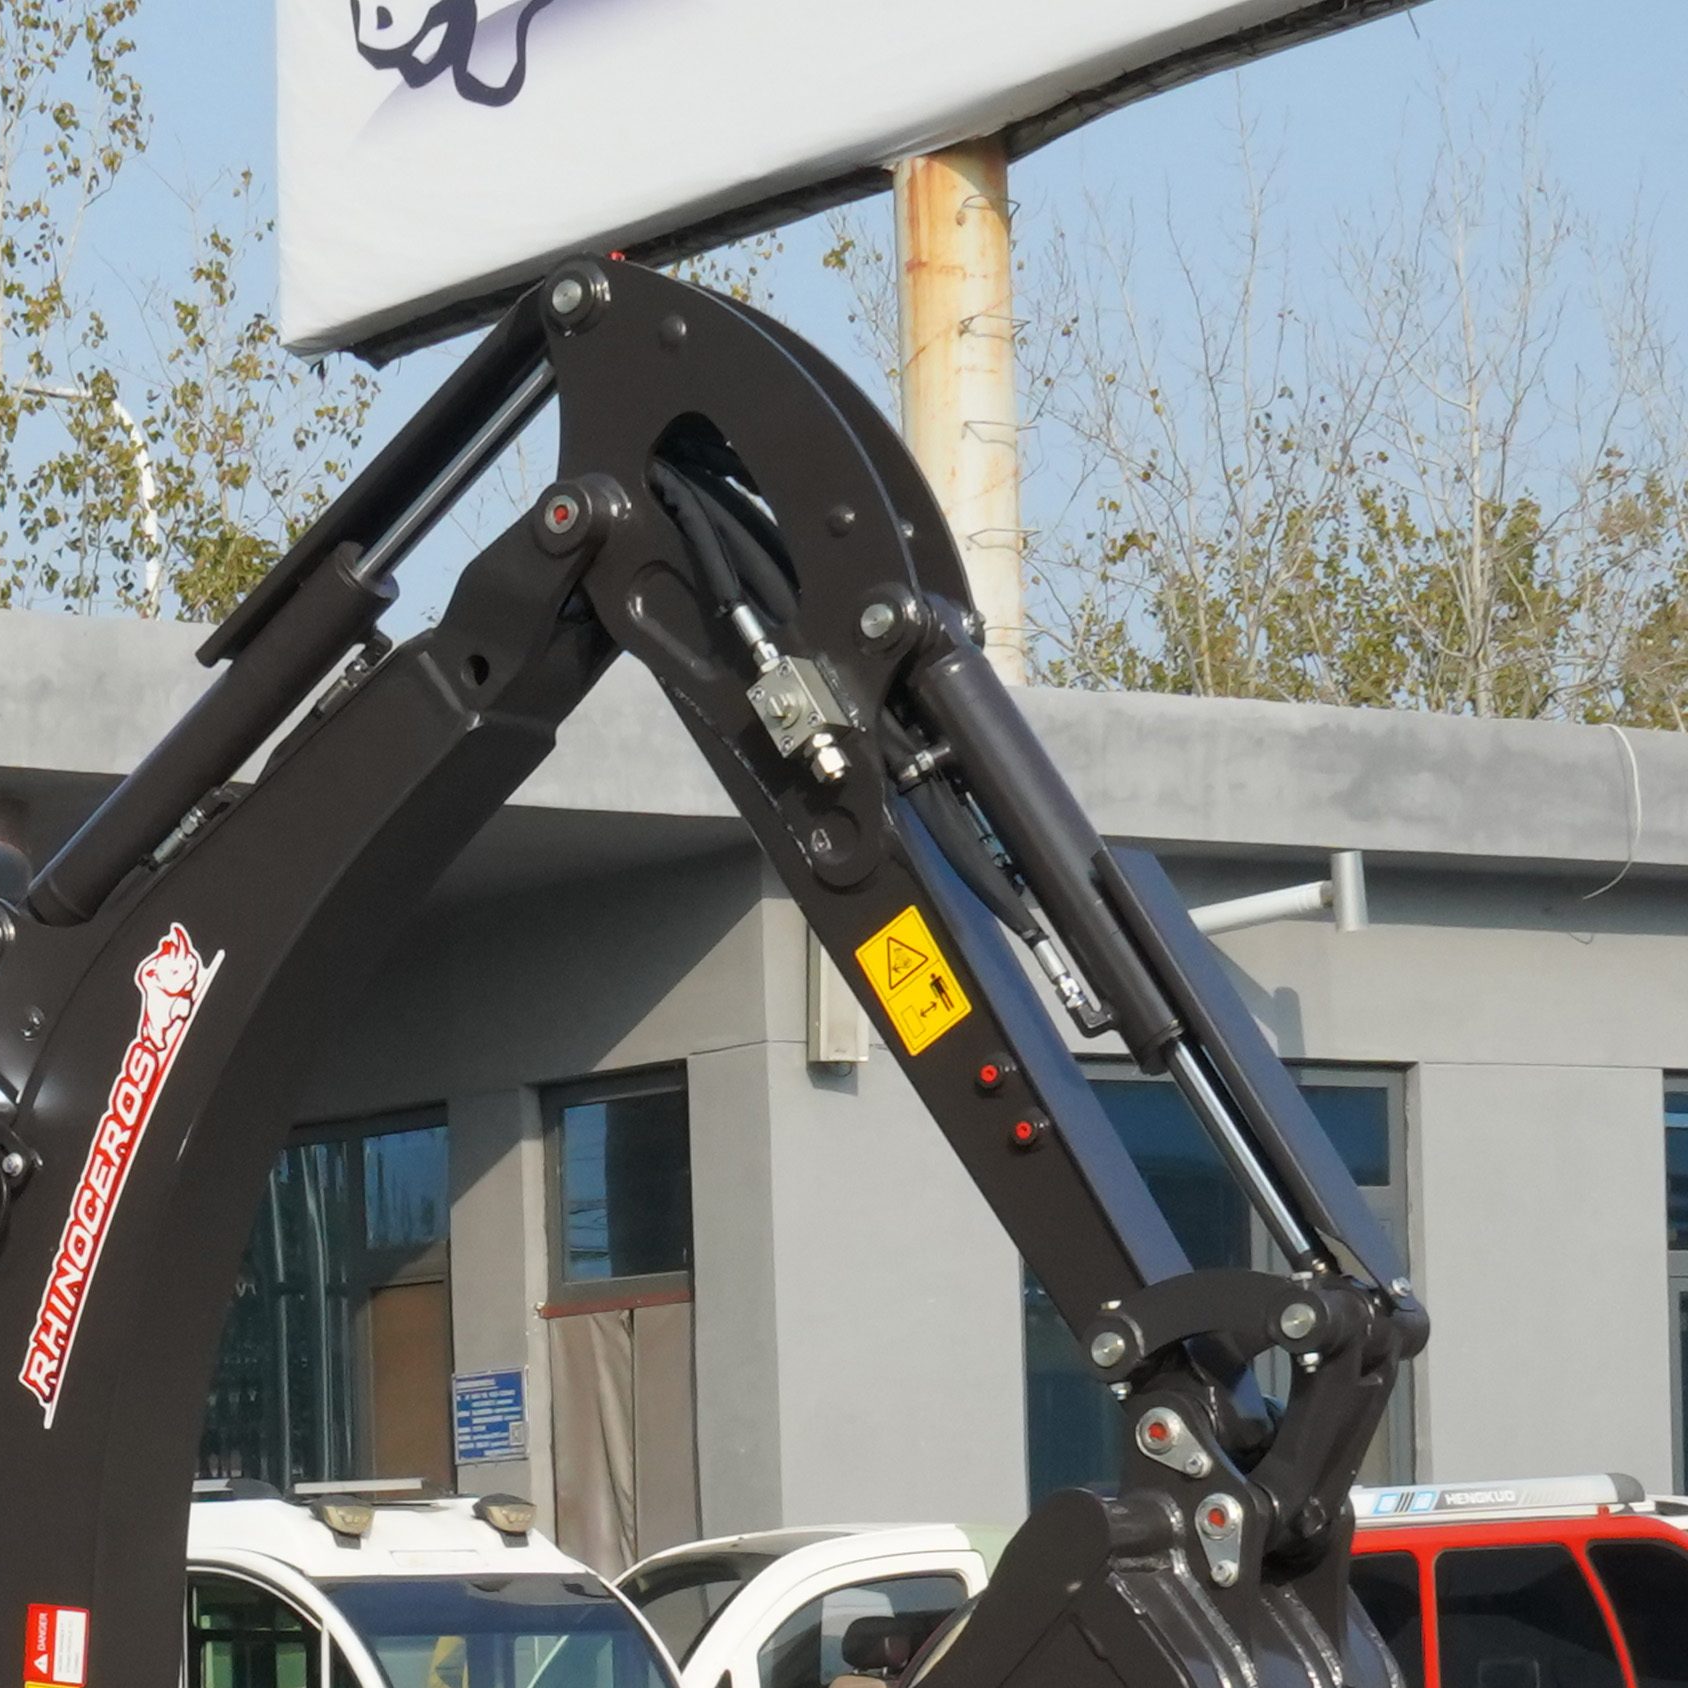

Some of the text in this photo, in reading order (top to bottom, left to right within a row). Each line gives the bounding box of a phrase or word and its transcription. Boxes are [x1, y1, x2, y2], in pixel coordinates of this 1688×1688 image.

[28, 1046, 157, 1399] RHINOCEROS
[1443, 1489, 1516, 1506] HENGKUO
[37, 1612, 48, 1652] DANGER
